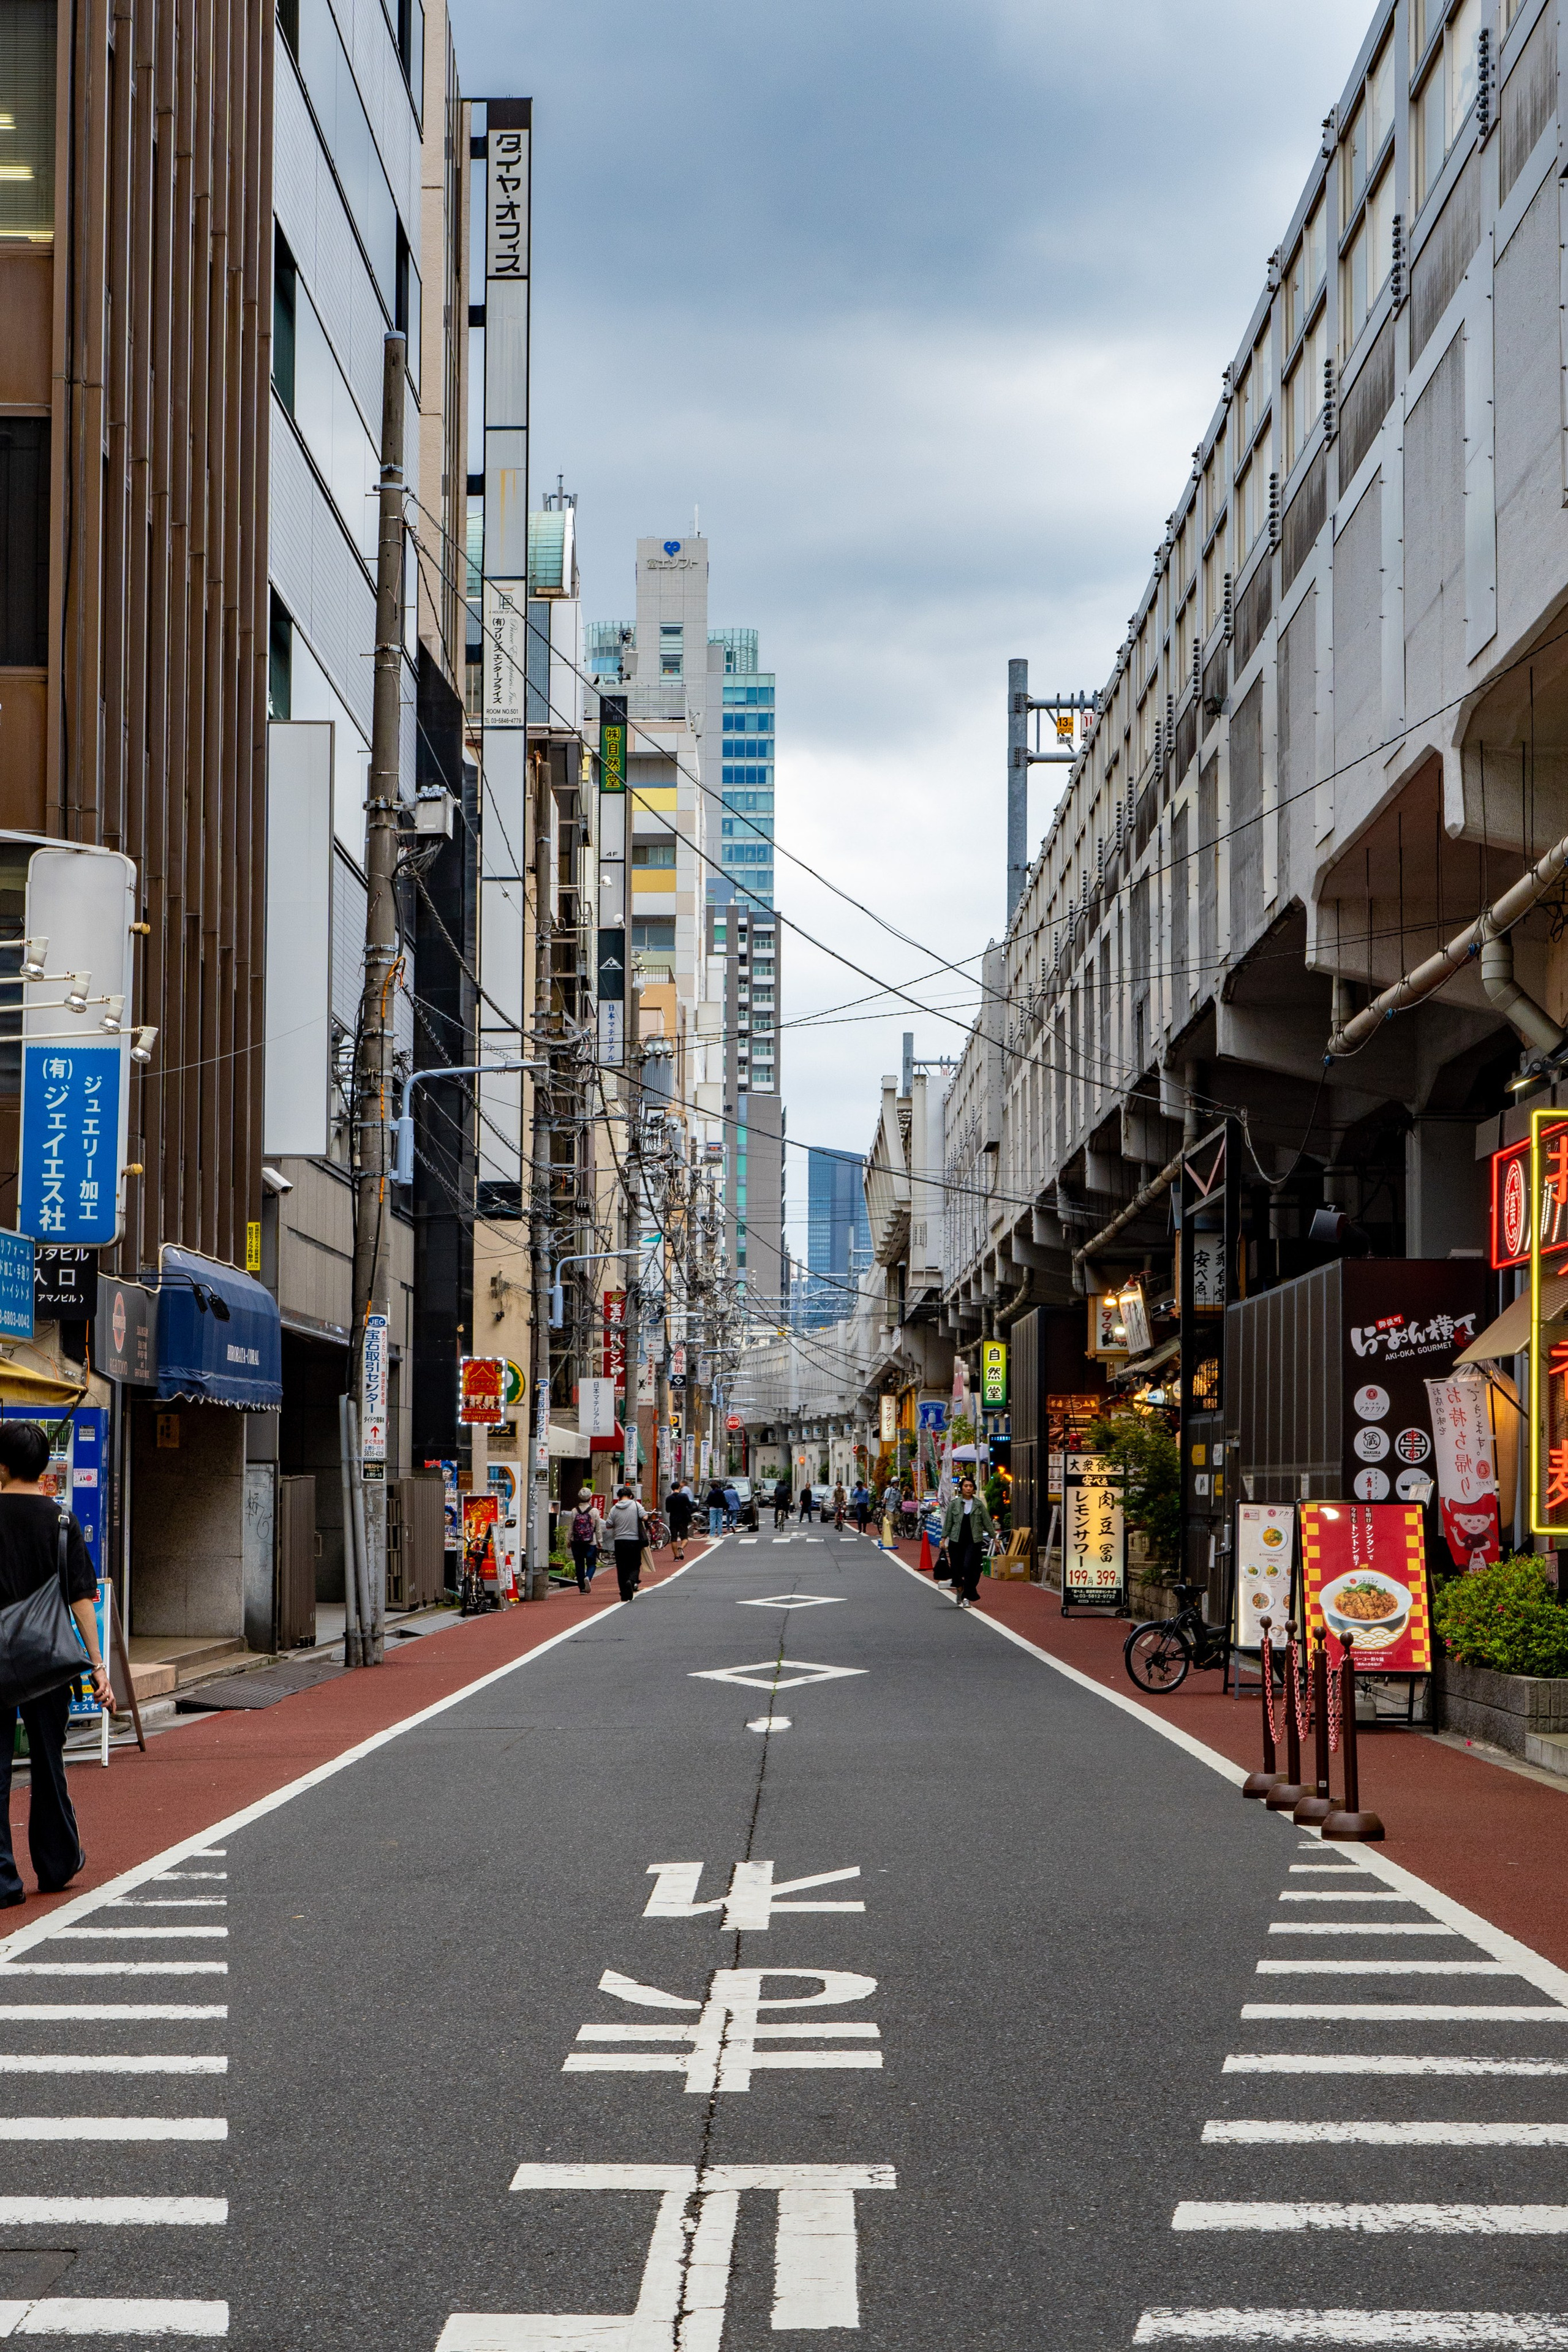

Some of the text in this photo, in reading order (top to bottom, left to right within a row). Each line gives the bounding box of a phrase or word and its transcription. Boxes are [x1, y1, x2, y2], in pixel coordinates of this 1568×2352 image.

[495, 134, 521, 273] ダイヤ・オフィス
[647, 559, 698, 569] 富士ソフト
[607, 1005, 616, 1061] 日本マテリアル
[78, 1076, 103, 1221] ジュエリー加工
[35, 1268, 75, 1286] 入口
[1351, 1313, 1476, 1357] らーめん横丁
[1378, 1316, 1402, 1329] 御徒町
[365, 1329, 380, 1414] 宝石取引センター
[987, 1348, 1001, 1400] 自然堂
[1385, 1341, 1452, 1361] AKI-OKA GOURMET
[1073, 1490, 1090, 1567] レモンサワー
